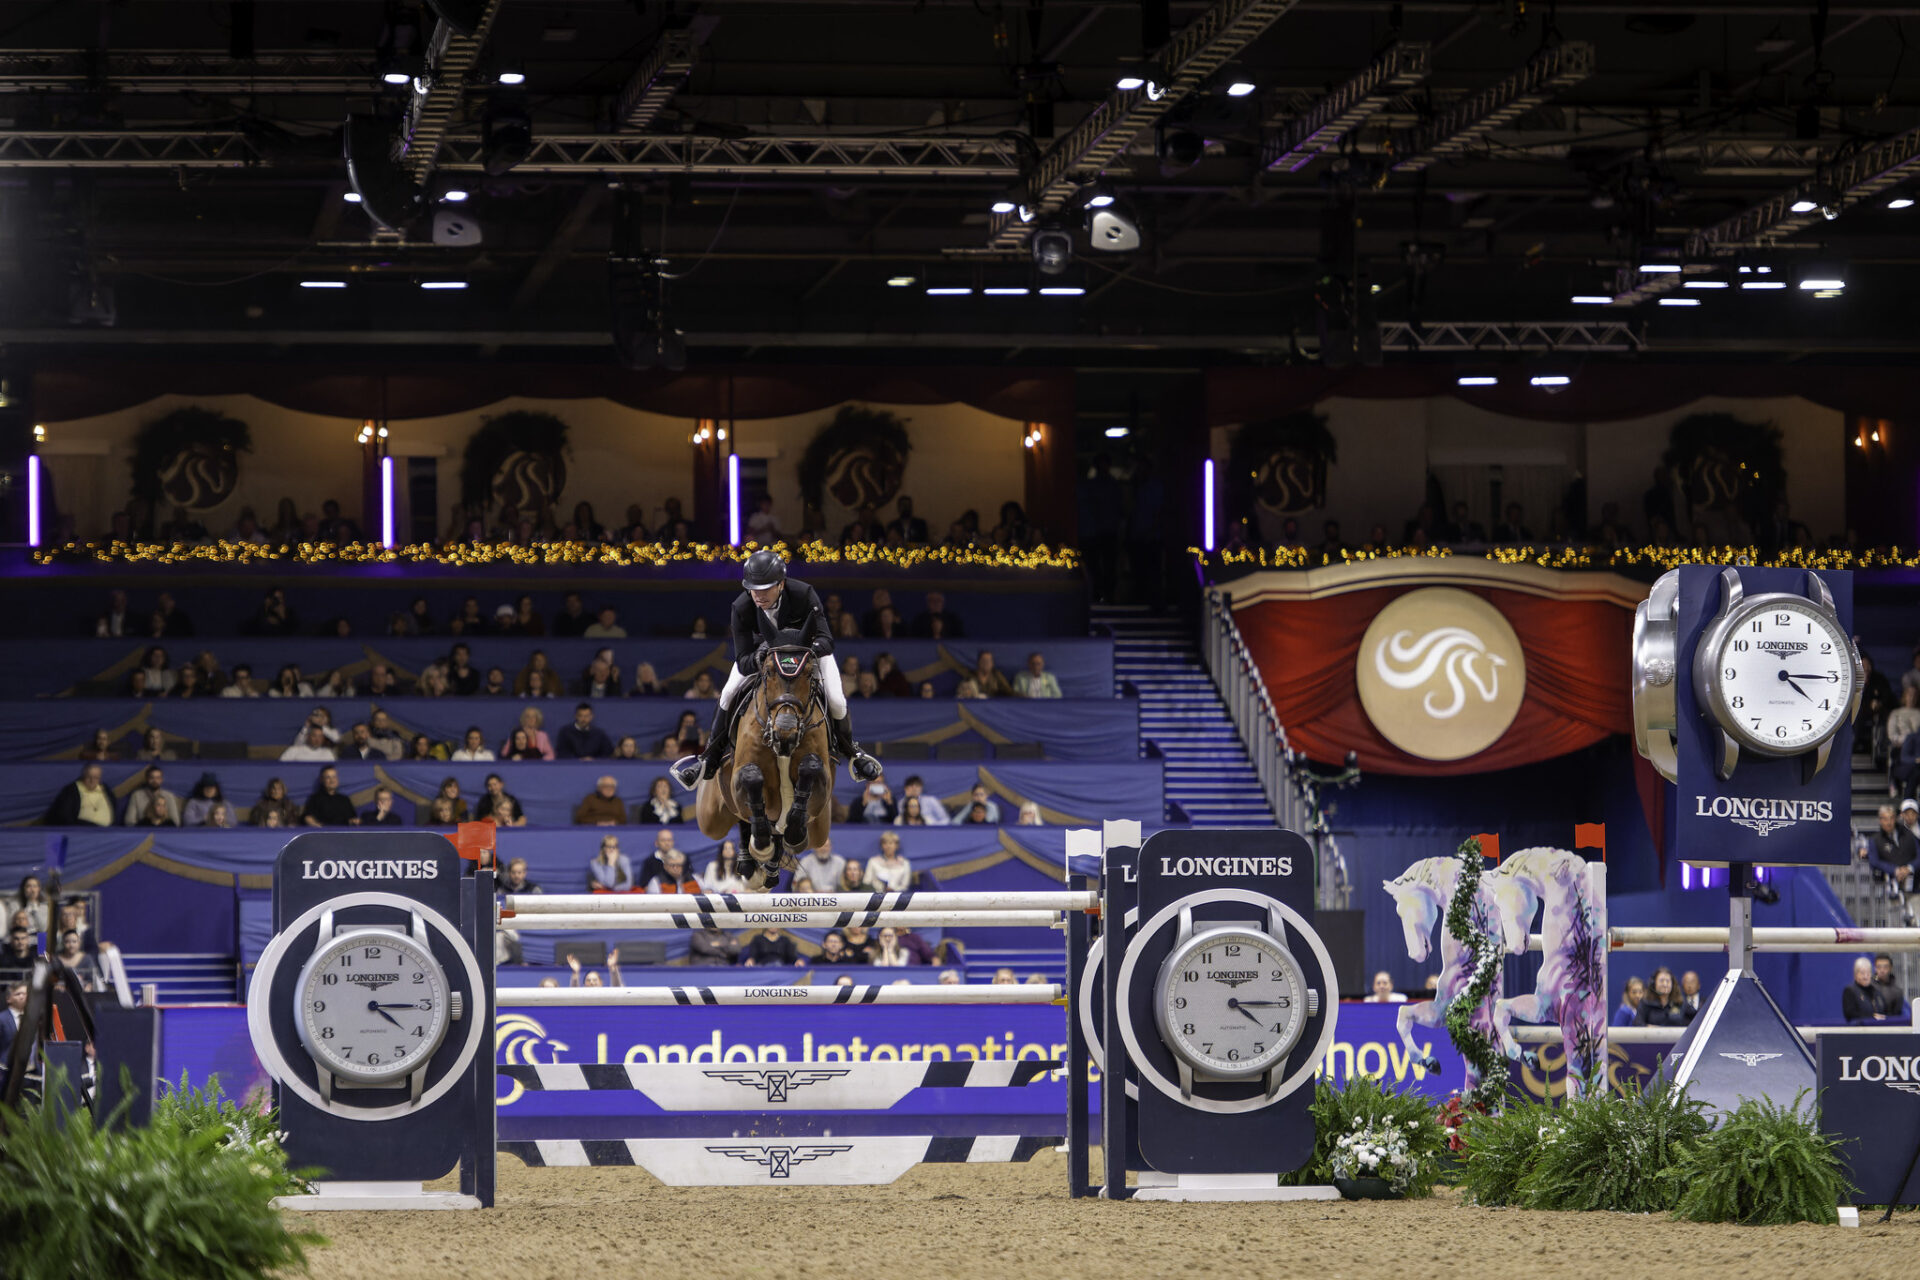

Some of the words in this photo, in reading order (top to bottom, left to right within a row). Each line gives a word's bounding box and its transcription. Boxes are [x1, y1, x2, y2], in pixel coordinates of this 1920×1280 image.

[1775, 614, 1790, 626] 12
[1753, 621, 1762, 632] 11
[1807, 623, 1811, 634] 1
[1734, 640, 1748, 651] 10
[1757, 641, 1808, 650] LONGINES
[1821, 643, 1831, 654] 2
[1725, 668, 1736, 680] 9
[1827, 671, 1838, 683] 3
[1732, 696, 1744, 708] 8
[1818, 699, 1830, 710] 4
[1751, 718, 1762, 730] 7
[1802, 719, 1812, 731] 5
[1776, 726, 1786, 738] 6
[1696, 796, 1833, 822] LONGINES
[302, 860, 438, 879] LONGINES
[1161, 857, 1293, 876] LONGINES
[772, 898, 837, 907] LONGINES
[745, 914, 808, 923] LONGINES
[365, 948, 381, 958] 12
[1225, 946, 1240, 956] 12
[341, 956, 351, 966] 11
[398, 955, 403, 965] 1
[1202, 953, 1212, 963] 11
[1257, 953, 1261, 963] 1
[322, 974, 338, 985] 10
[347, 974, 399, 982] LONGINES
[413, 973, 424, 984] 2
[1184, 972, 1198, 982] 10
[1272, 970, 1282, 981] 2
[745, 989, 808, 998] LONGINES
[314, 1001, 325, 1012] 9
[420, 999, 432, 1011] 3
[1176, 997, 1187, 1009] 9
[1279, 997, 1290, 1008] 3
[322, 1027, 334, 1039] 8
[411, 1026, 424, 1037] 4
[1183, 1024, 1195, 1035] 8
[1270, 1023, 1283, 1033] 4
[342, 1047, 352, 1058] 7
[395, 1046, 405, 1057] 5
[1203, 1043, 1213, 1054] 7
[1254, 1043, 1264, 1053] 5
[368, 1053, 379, 1064] 6
[1228, 1049, 1239, 1061] 6
[1315, 1034, 1432, 1081] how
